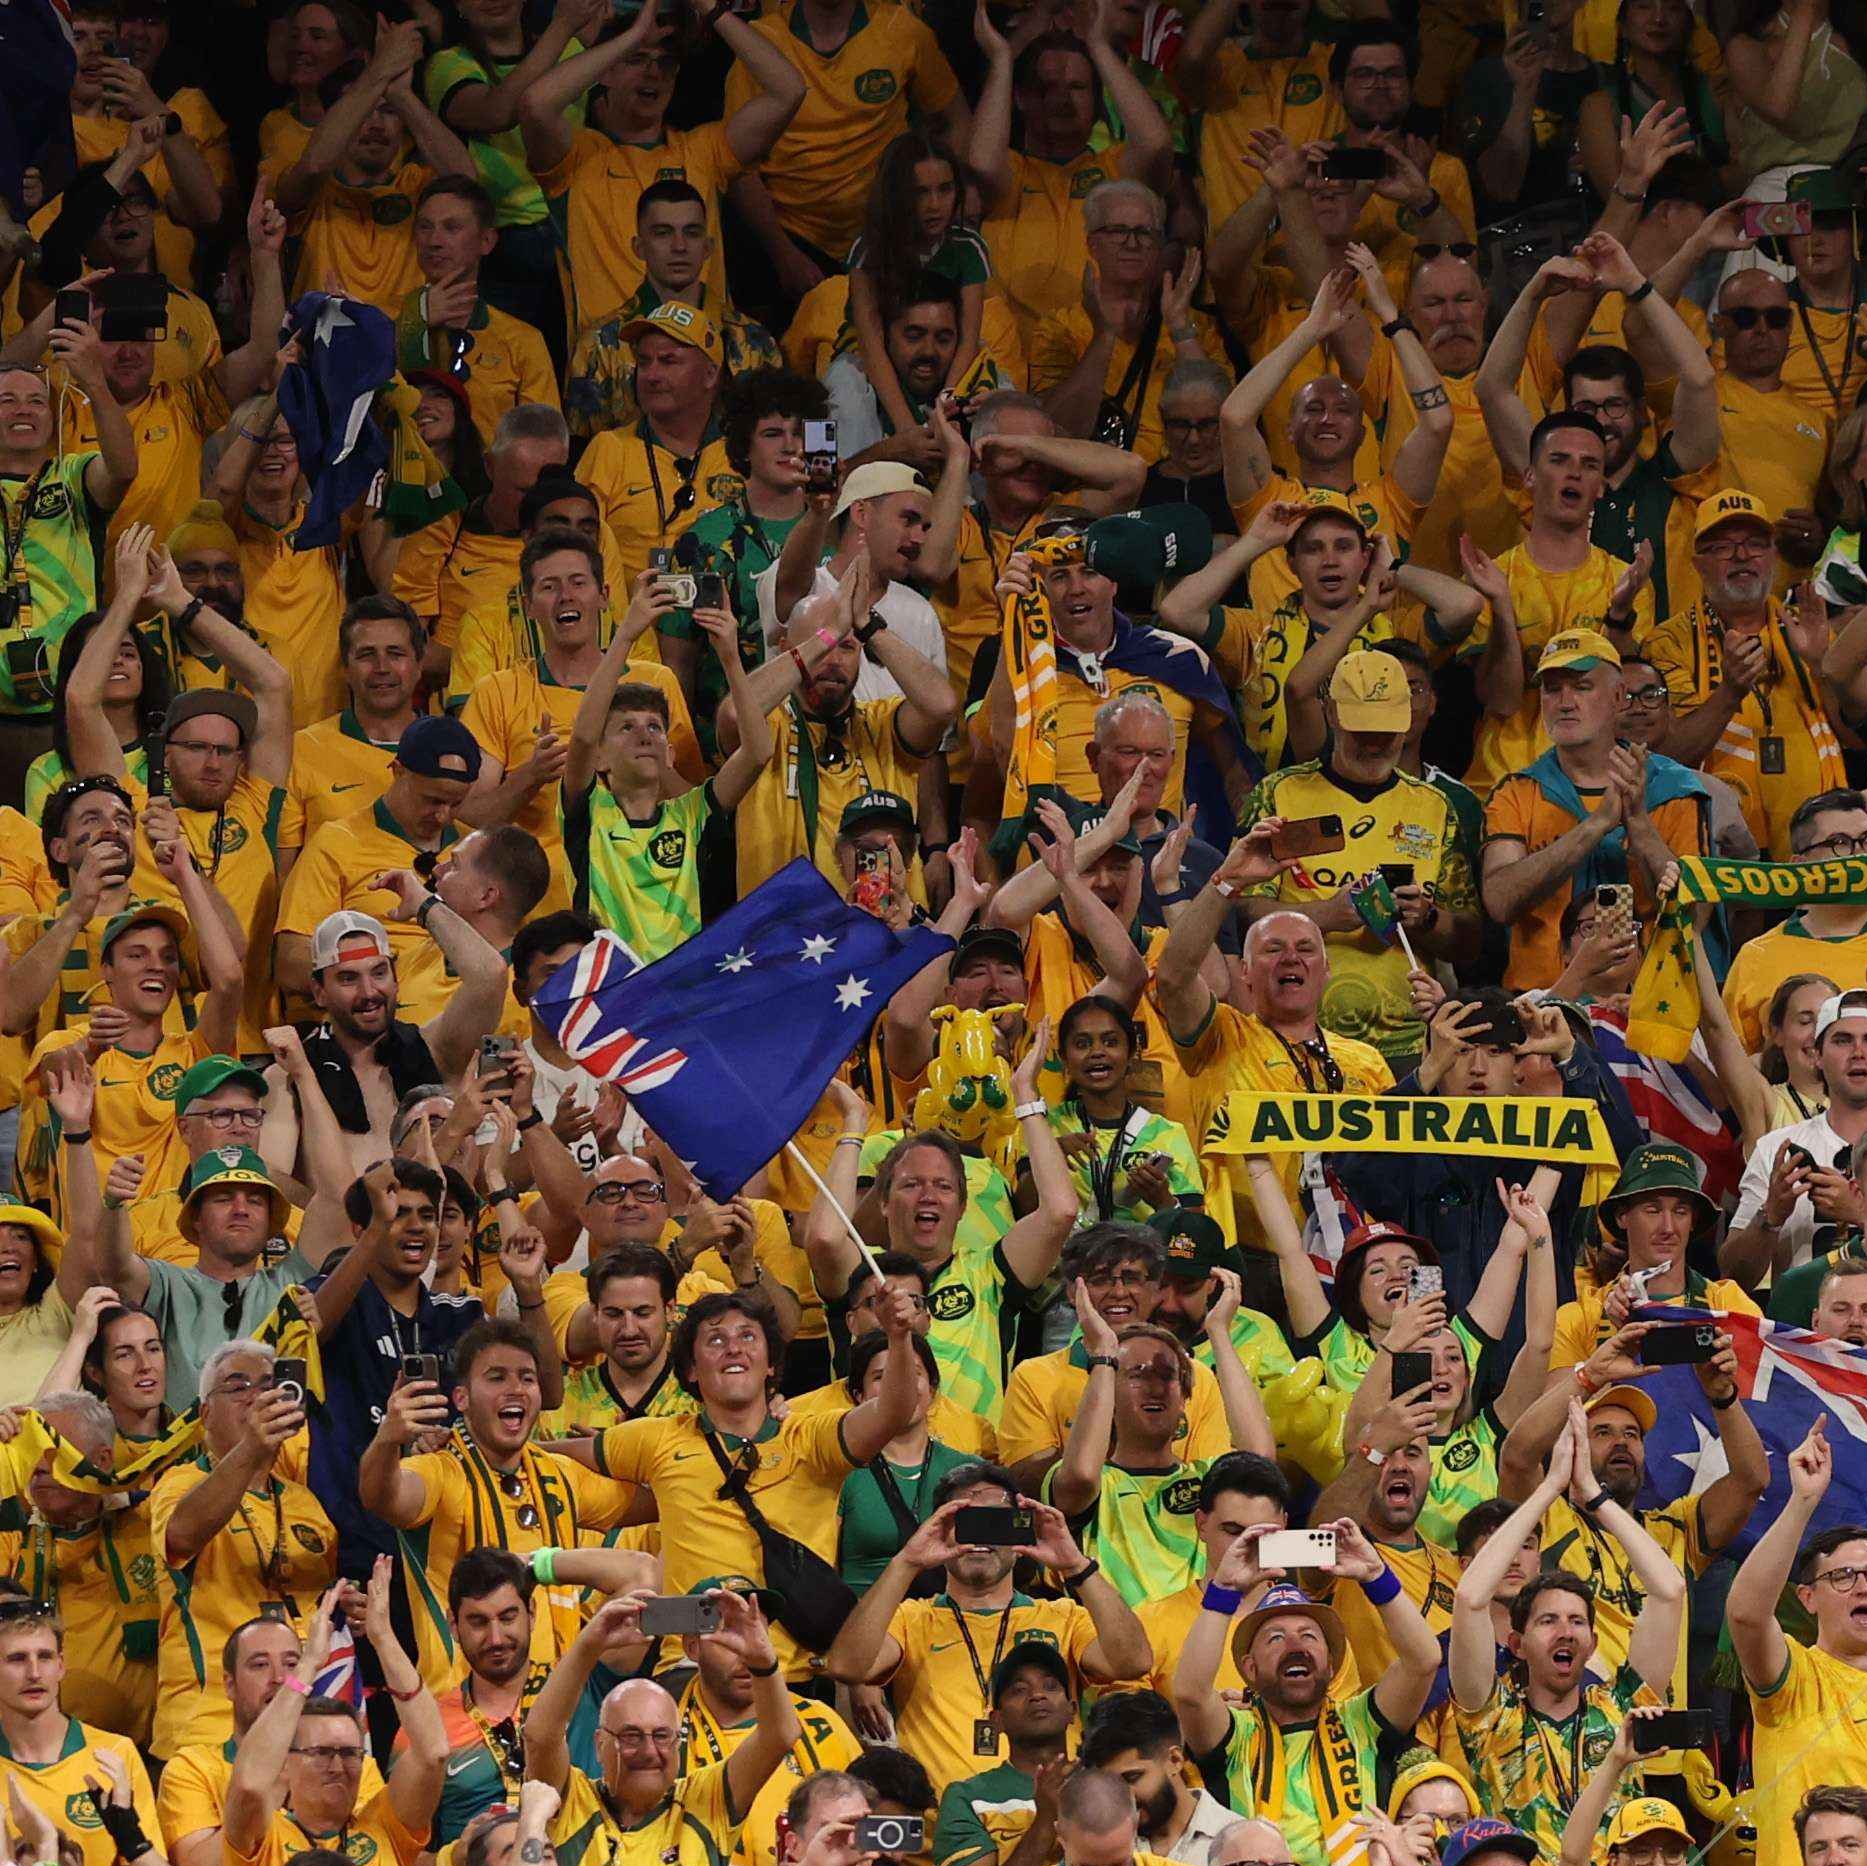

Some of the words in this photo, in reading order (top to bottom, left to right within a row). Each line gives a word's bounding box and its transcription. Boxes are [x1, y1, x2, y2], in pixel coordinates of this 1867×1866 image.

[1717, 496, 1753, 514] AUS
[1162, 530, 1178, 570] AUS
[860, 795, 898, 810] AUS
[1249, 1098, 1597, 1152] AUSTRALIA
